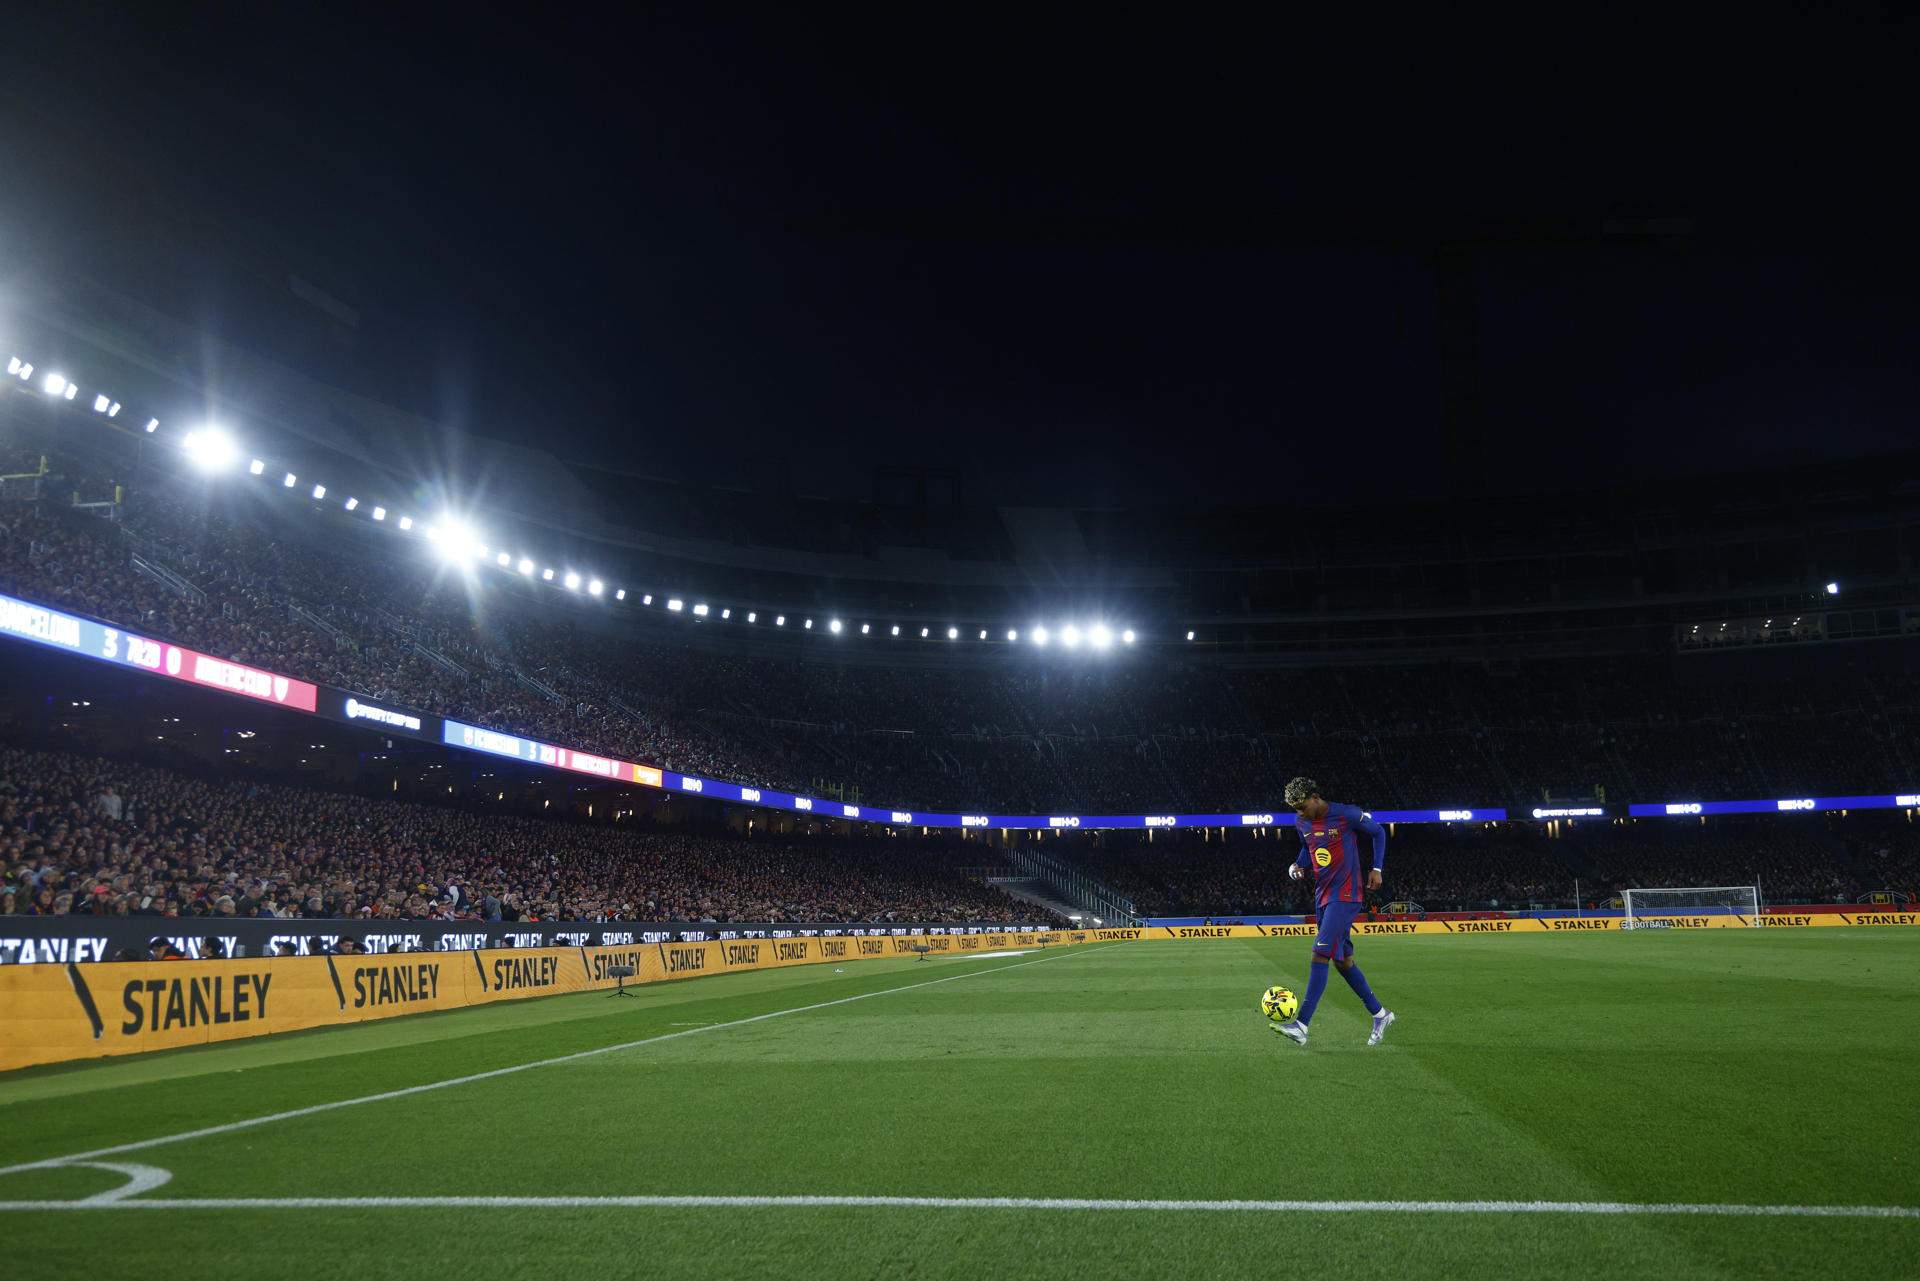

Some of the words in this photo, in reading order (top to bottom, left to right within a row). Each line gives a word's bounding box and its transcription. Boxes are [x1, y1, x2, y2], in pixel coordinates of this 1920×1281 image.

[103, 628, 118, 658] 3
[1457, 922, 1512, 932] STANLEY
[1554, 920, 1610, 930] STANLEY
[1856, 915, 1917, 926] STANLEY
[1099, 929, 1141, 940] STANLEY
[1180, 928, 1232, 938] STANLEY
[1271, 926, 1316, 936] STANLE
[1364, 924, 1417, 934] STANLEY
[0, 938, 107, 964] TANLEY
[729, 945, 760, 965] STANLEY
[780, 942, 808, 961] STANLEY
[825, 941, 847, 957] STANLEY
[863, 940, 884, 954] STANLEY
[670, 948, 706, 972] STANLEY
[494, 957, 558, 991] STANLEY
[354, 964, 439, 1008] STANLEY
[122, 973, 272, 1035] STANLEY
